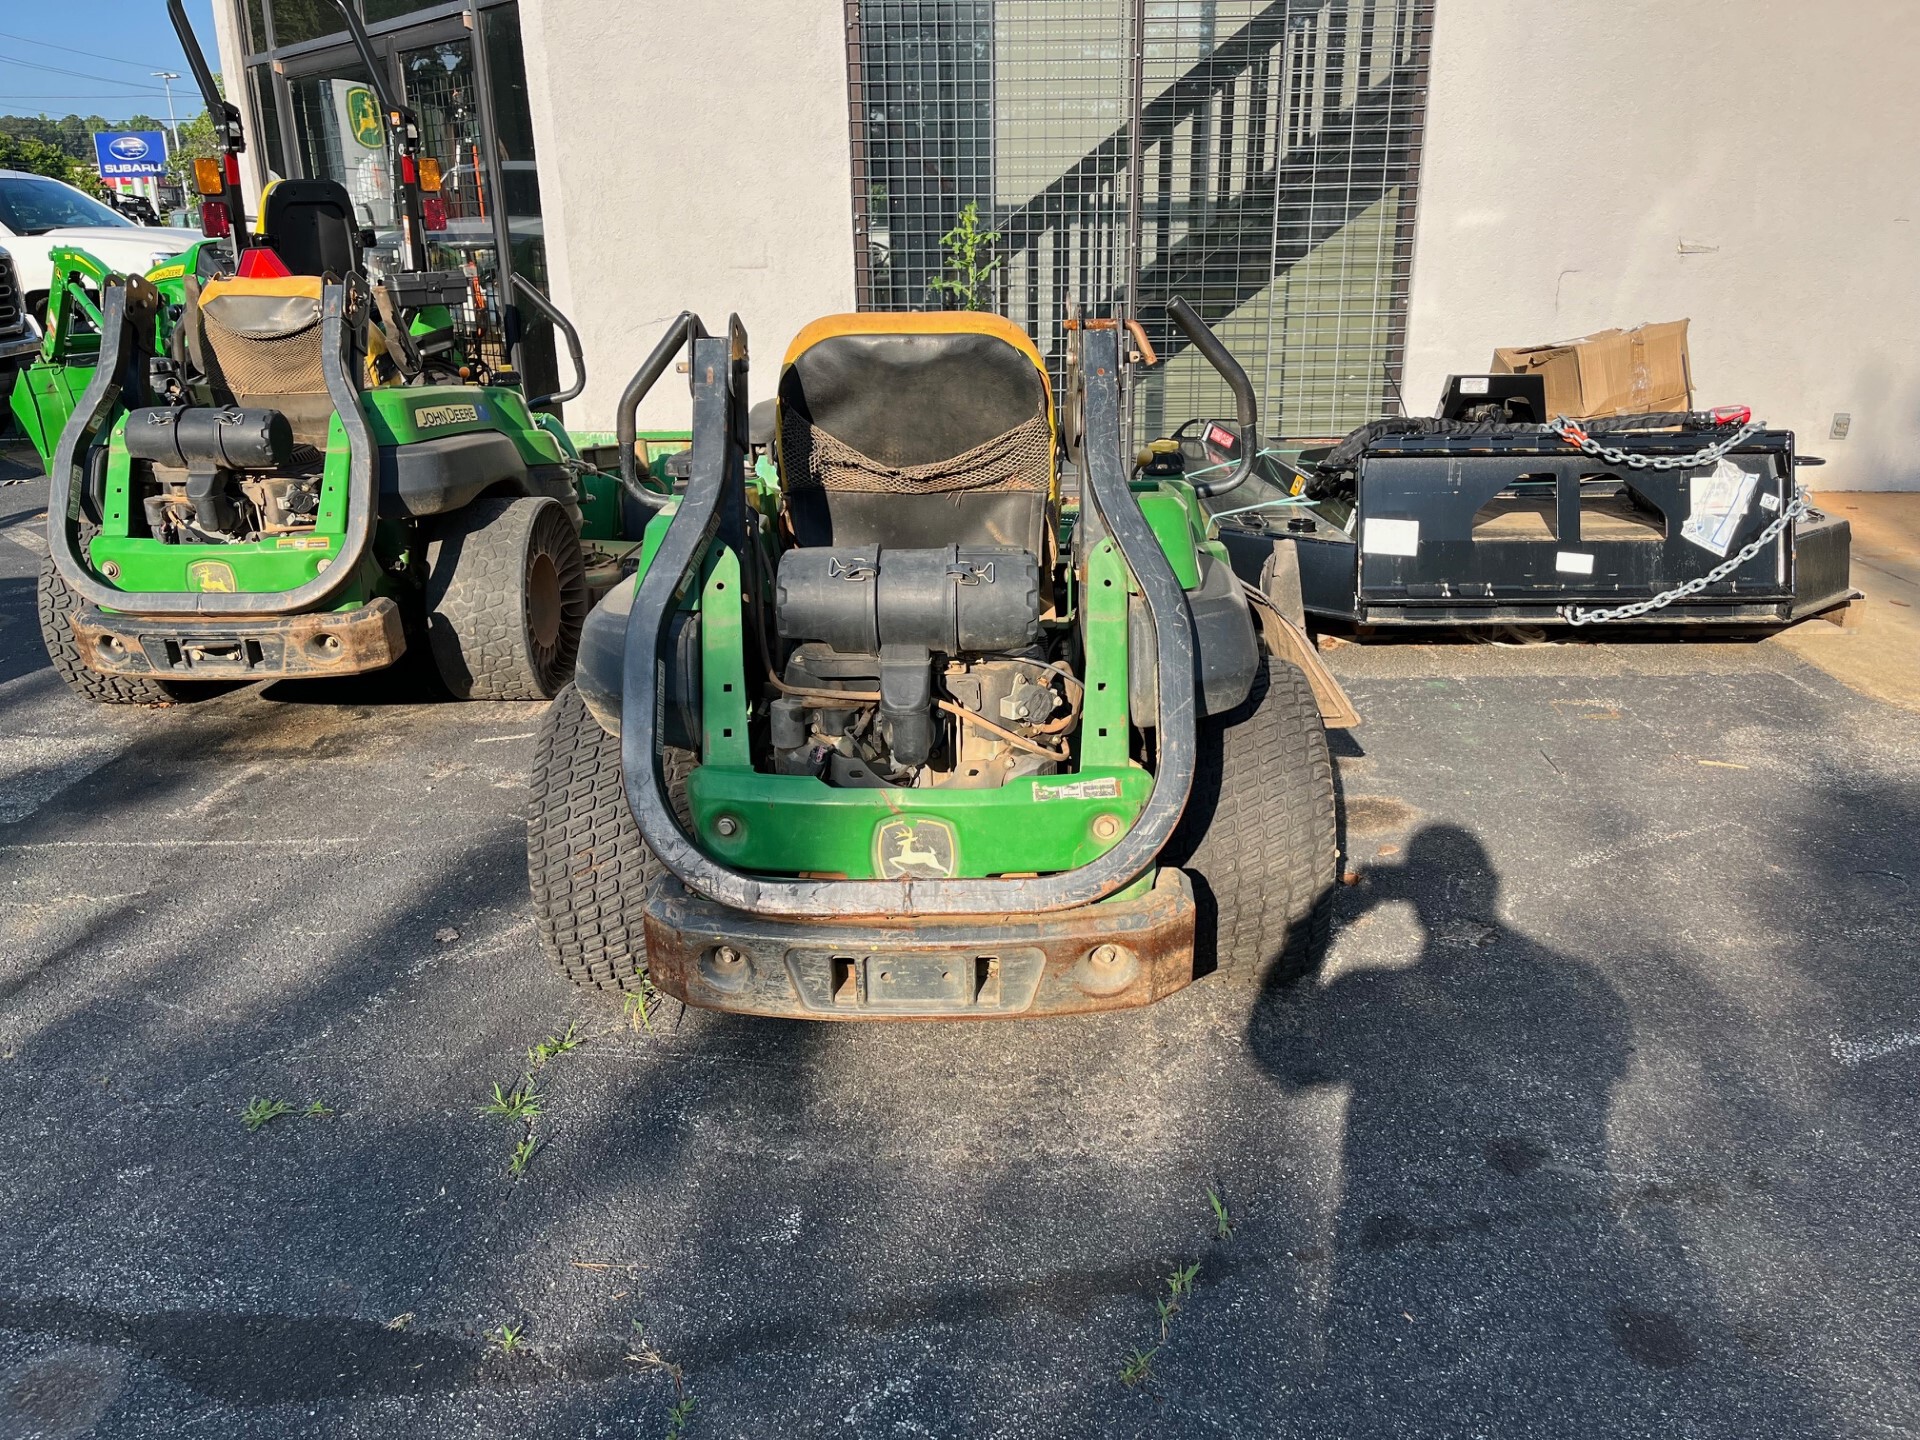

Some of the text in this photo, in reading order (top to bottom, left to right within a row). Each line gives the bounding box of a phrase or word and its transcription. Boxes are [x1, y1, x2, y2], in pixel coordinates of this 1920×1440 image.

[105, 164, 162, 173] SUBARU
[421, 407, 477, 426] JOHN DEERE
